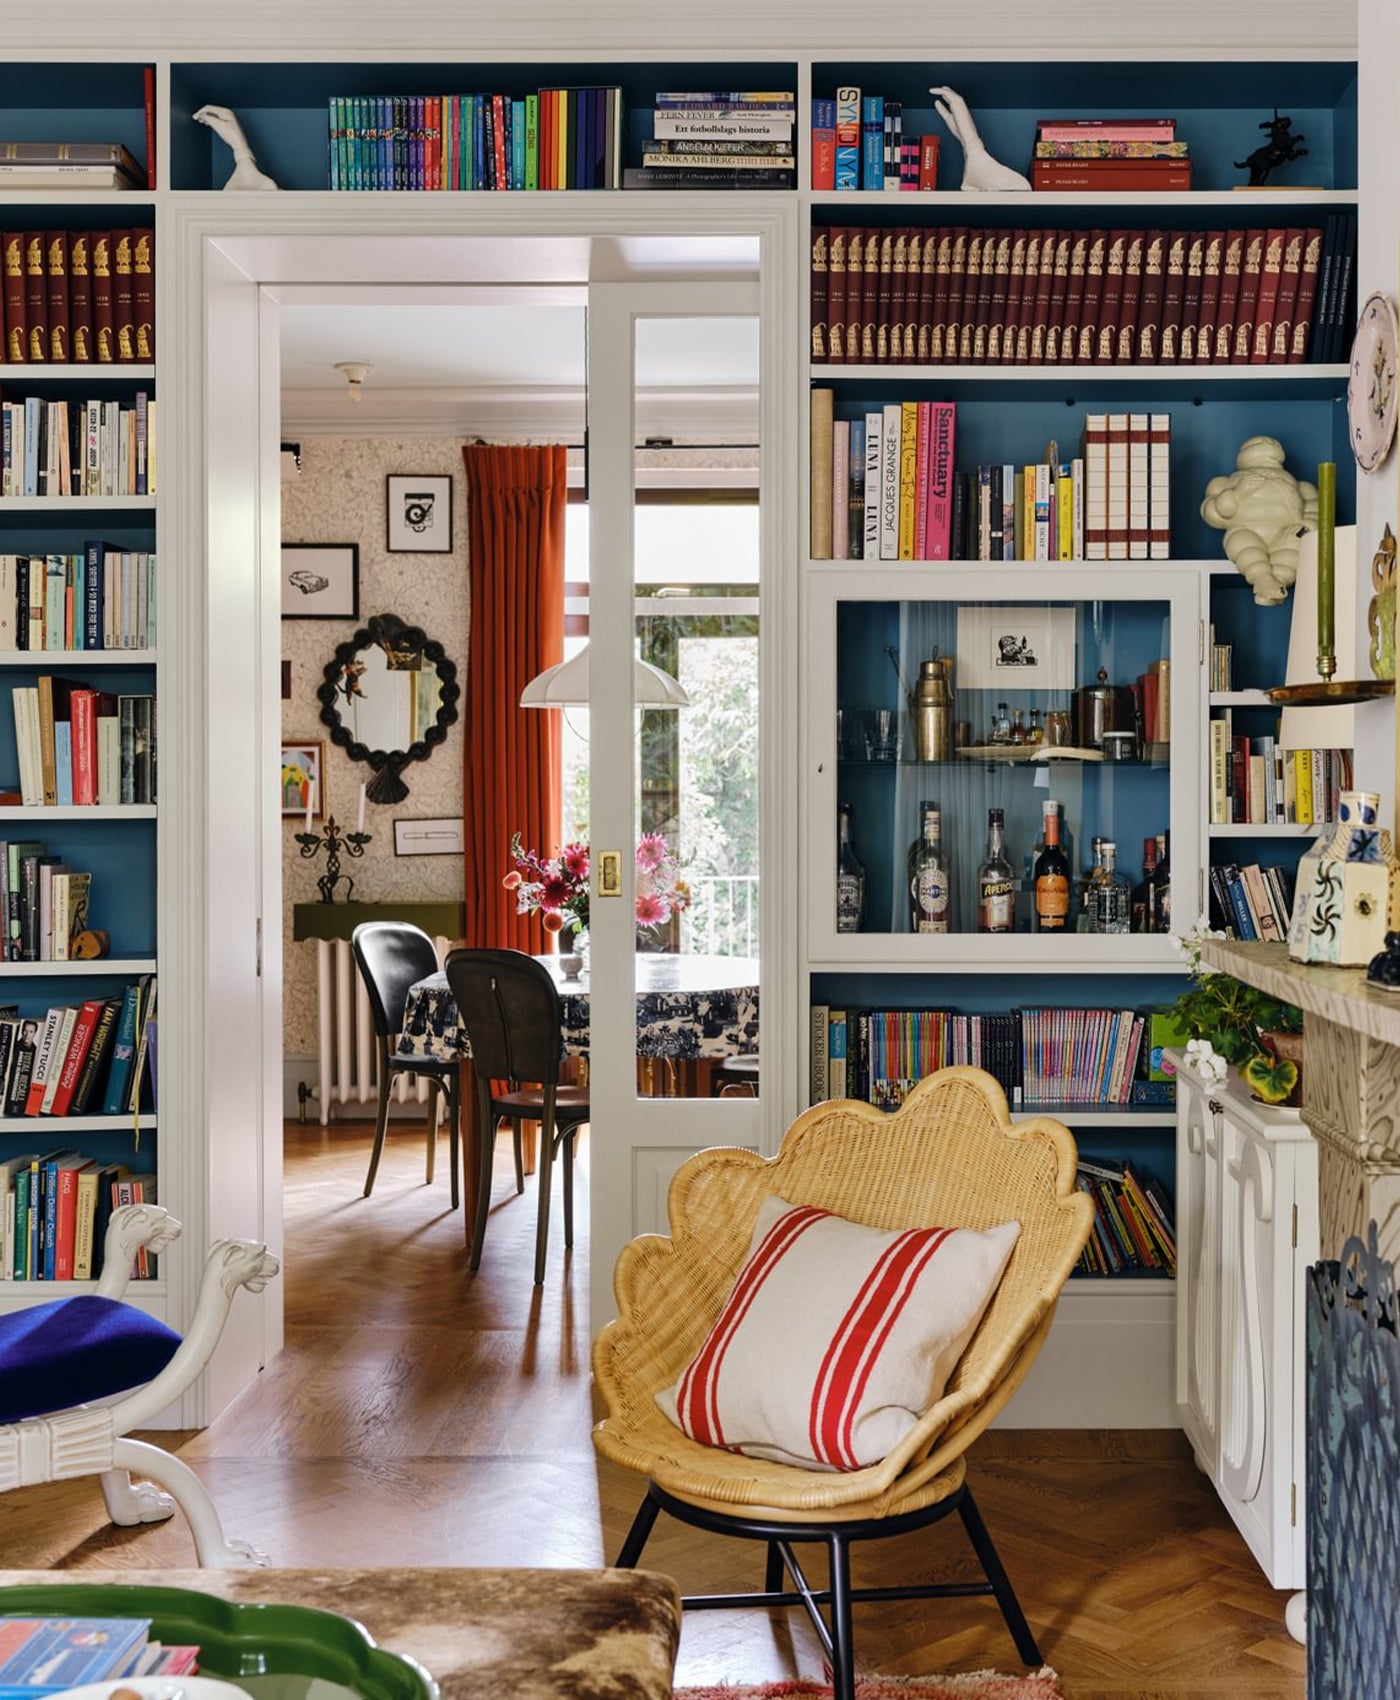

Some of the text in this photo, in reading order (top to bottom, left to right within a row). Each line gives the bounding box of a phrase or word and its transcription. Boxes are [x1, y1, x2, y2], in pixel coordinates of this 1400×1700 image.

[660, 111, 715, 119] FERN FEVER
[690, 124, 737, 135] fotbollslags
[738, 124, 770, 134] historia
[648, 154, 688, 163] MONIKA
[690, 156, 736, 164] AHLBERG
[676, 142, 745, 151] ANSELM KIEFER
[902, 408, 917, 498] May I Come In?
[933, 408, 953, 499] Sanctuary
[866, 434, 879, 542] LUNA LUNA
[885, 438, 898, 532] JACQUES GRANGE
[102, 1007, 115, 1020] IAN
[36, 1015, 57, 1080] STANLEY TUCCI
[69, 1024, 86, 1060] WENGER
[89, 1024, 109, 1062] WRIGHT
[814, 1012, 824, 1093] STICKER BOOK
[18, 1052, 32, 1102] TOTAL RECALL
[48, 1171, 56, 1197] Trillion
[63, 1172, 71, 1194] FMCG
[120, 1189, 130, 1206] ALCH
